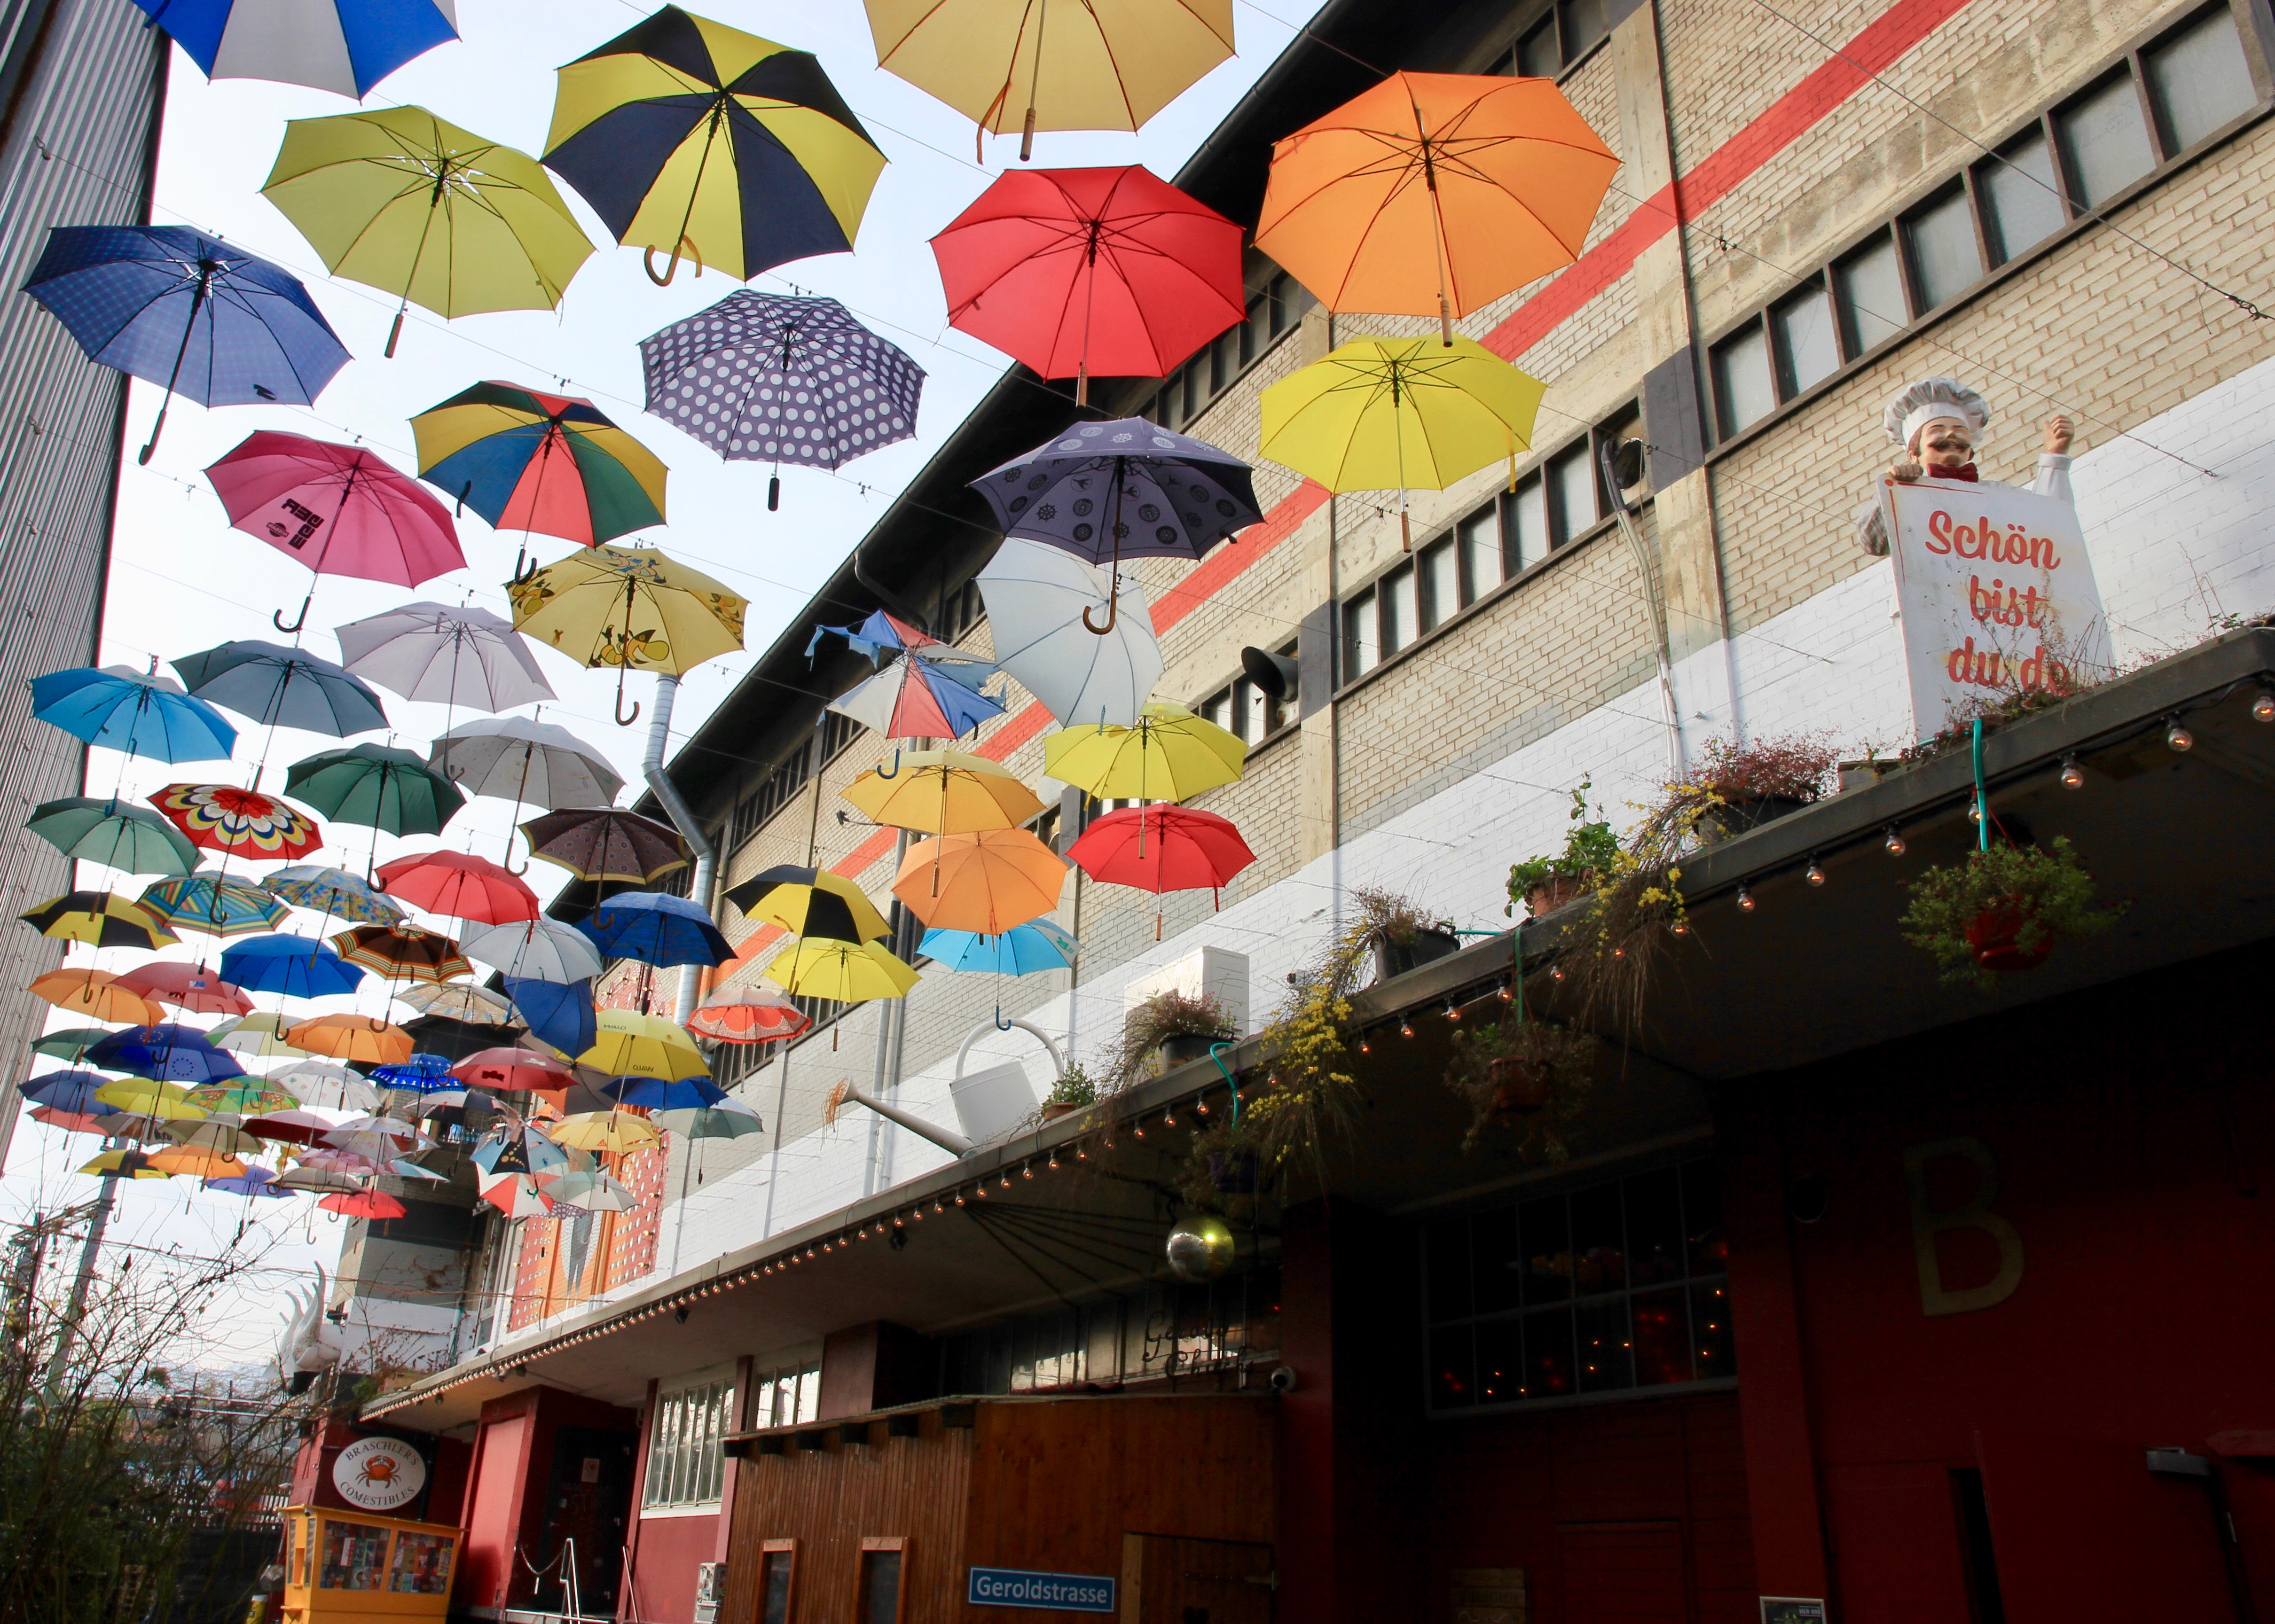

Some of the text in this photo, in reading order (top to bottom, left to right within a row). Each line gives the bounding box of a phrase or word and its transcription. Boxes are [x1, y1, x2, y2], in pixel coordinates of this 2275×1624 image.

[1925, 510, 2061, 570] Schön
[1969, 575, 2049, 629] bist
[1948, 636, 2009, 688] du
[1902, 1136, 2024, 1316] B
[340, 1482, 415, 1505] COMESTIBLES
[977, 1576, 1107, 1603] Geroldstrasse
